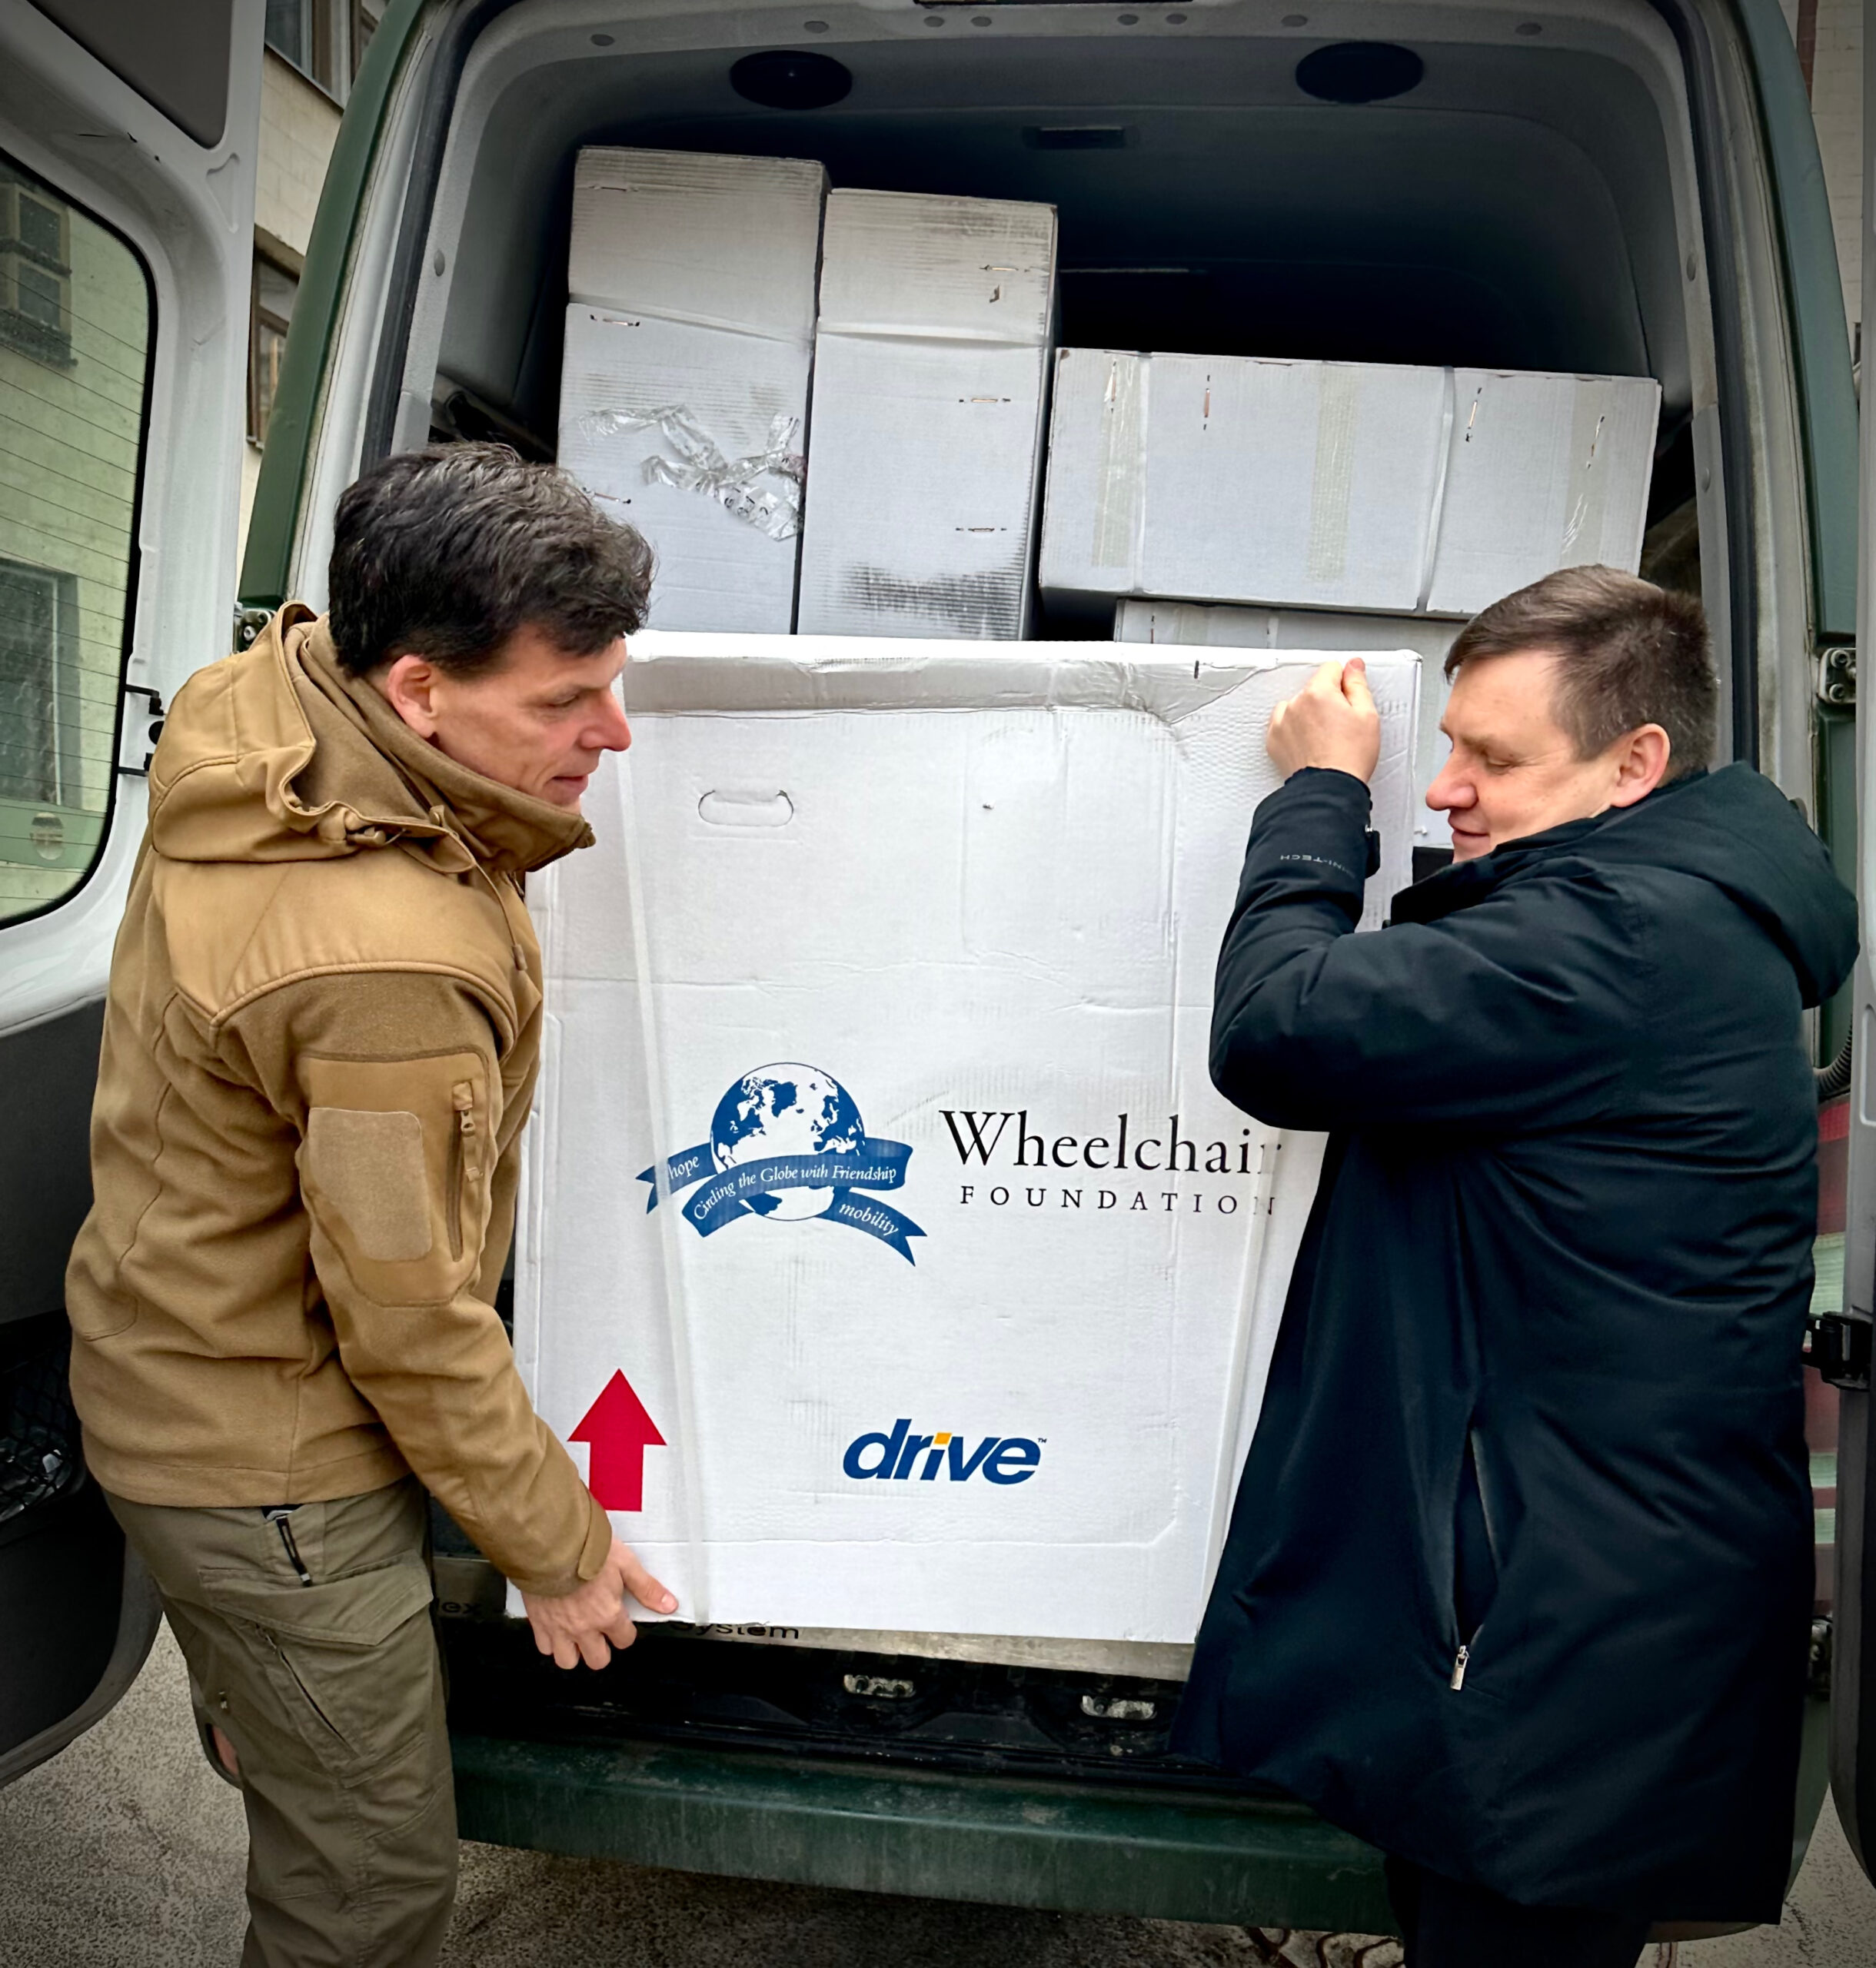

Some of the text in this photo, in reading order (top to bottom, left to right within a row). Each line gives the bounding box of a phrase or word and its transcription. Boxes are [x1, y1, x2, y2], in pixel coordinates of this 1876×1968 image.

[668, 1155, 700, 1180] hope
[694, 1163, 897, 1221] Circling the Globe with Friendship
[839, 1202, 899, 1236] mobility
[843, 1418, 1041, 1485] drive
